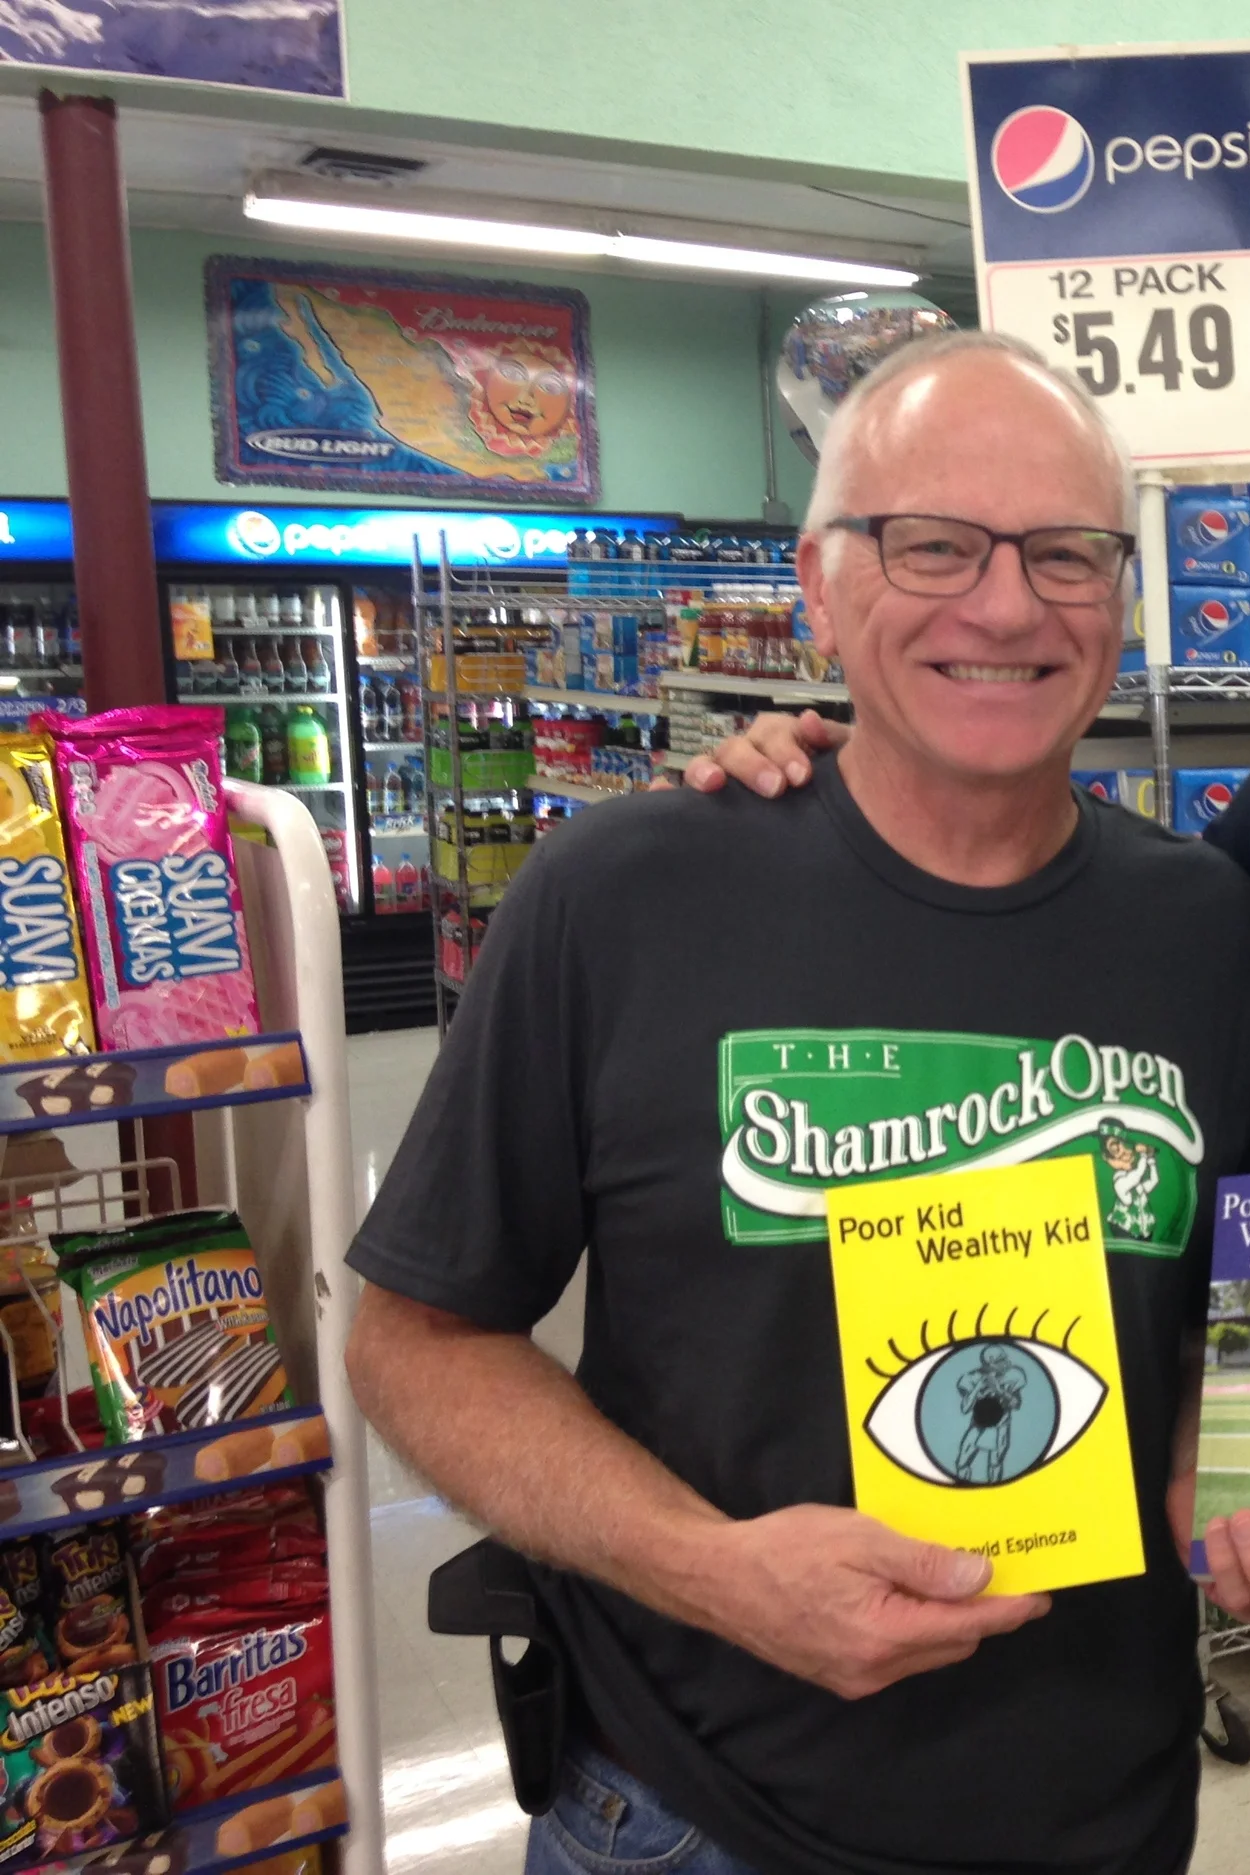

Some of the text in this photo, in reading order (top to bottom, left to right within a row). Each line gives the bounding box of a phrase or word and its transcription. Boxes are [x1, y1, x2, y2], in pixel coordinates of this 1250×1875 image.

[1049, 262, 1227, 299] 12 PACK
[320, 438, 395, 457] LIGHT
[283, 522, 388, 557] pep
[0, 856, 77, 985] SUAVI
[115, 860, 176, 984] CREMAS
[162, 852, 241, 976] SUAVI
[743, 1033, 1187, 1178] Shamrock Open
[838, 1202, 964, 1244] Poor Kid
[915, 1216, 1091, 1265] Wealthy Kid
[94, 1257, 264, 1344] Napolitano
[955, 1528, 1078, 1558] avid Espinoza
[166, 1623, 307, 1713] Barritas
[6, 1675, 116, 1743] Intenso
[111, 1692, 153, 1728] NEW
[219, 1677, 298, 1736] fresa
